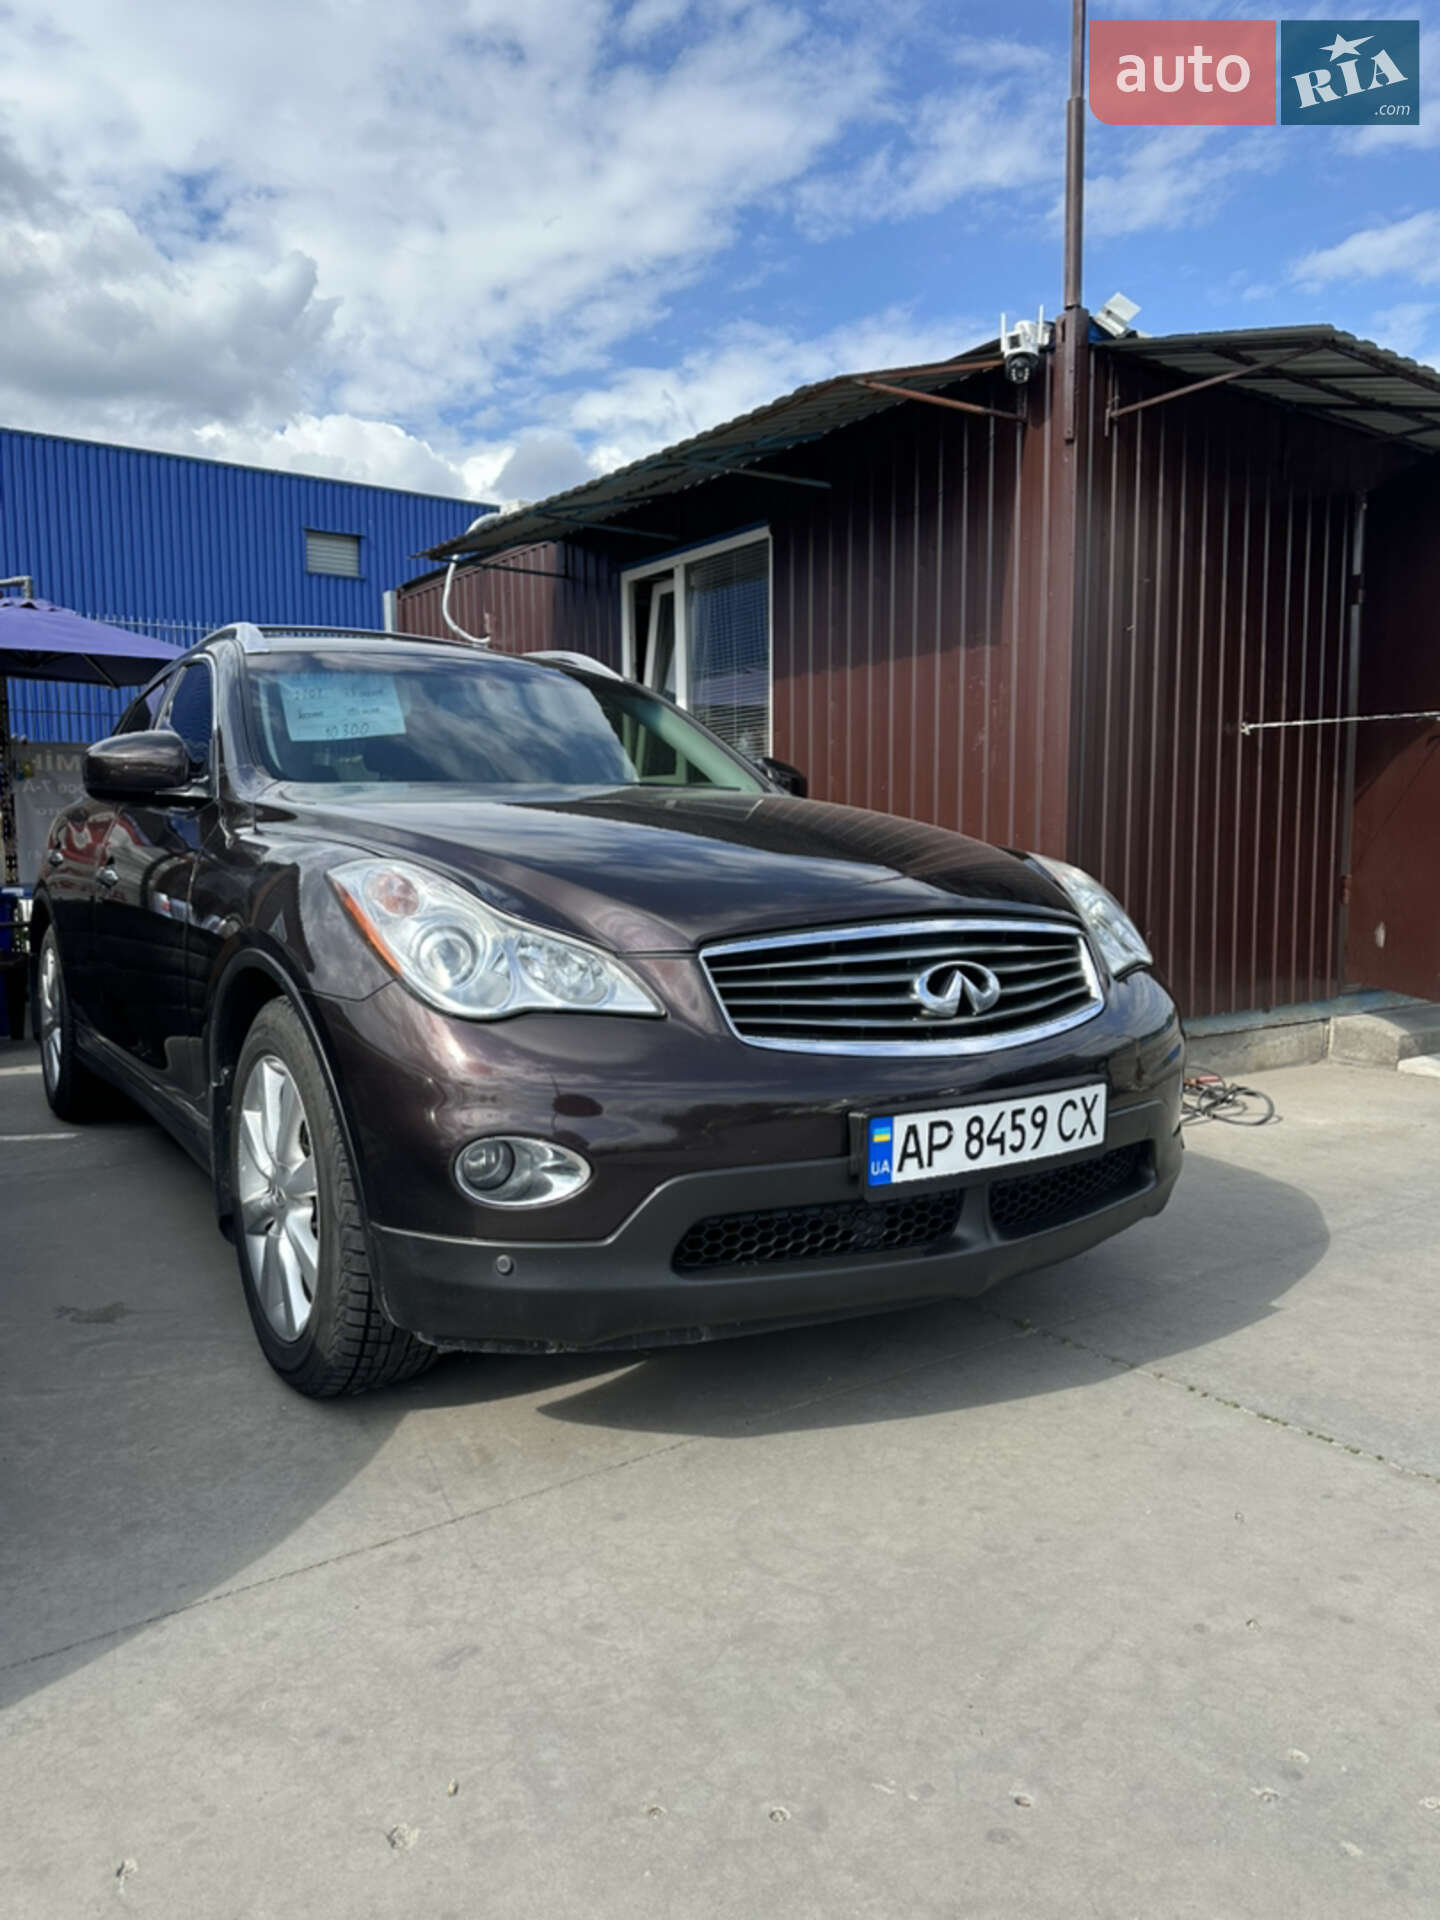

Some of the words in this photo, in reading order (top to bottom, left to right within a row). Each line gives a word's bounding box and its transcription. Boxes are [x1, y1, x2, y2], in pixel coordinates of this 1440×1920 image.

[897, 1119, 954, 1173] AP
[964, 1104, 1048, 1161] 8459
[1057, 1093, 1099, 1143] CX
[871, 1159, 891, 1176] UA
